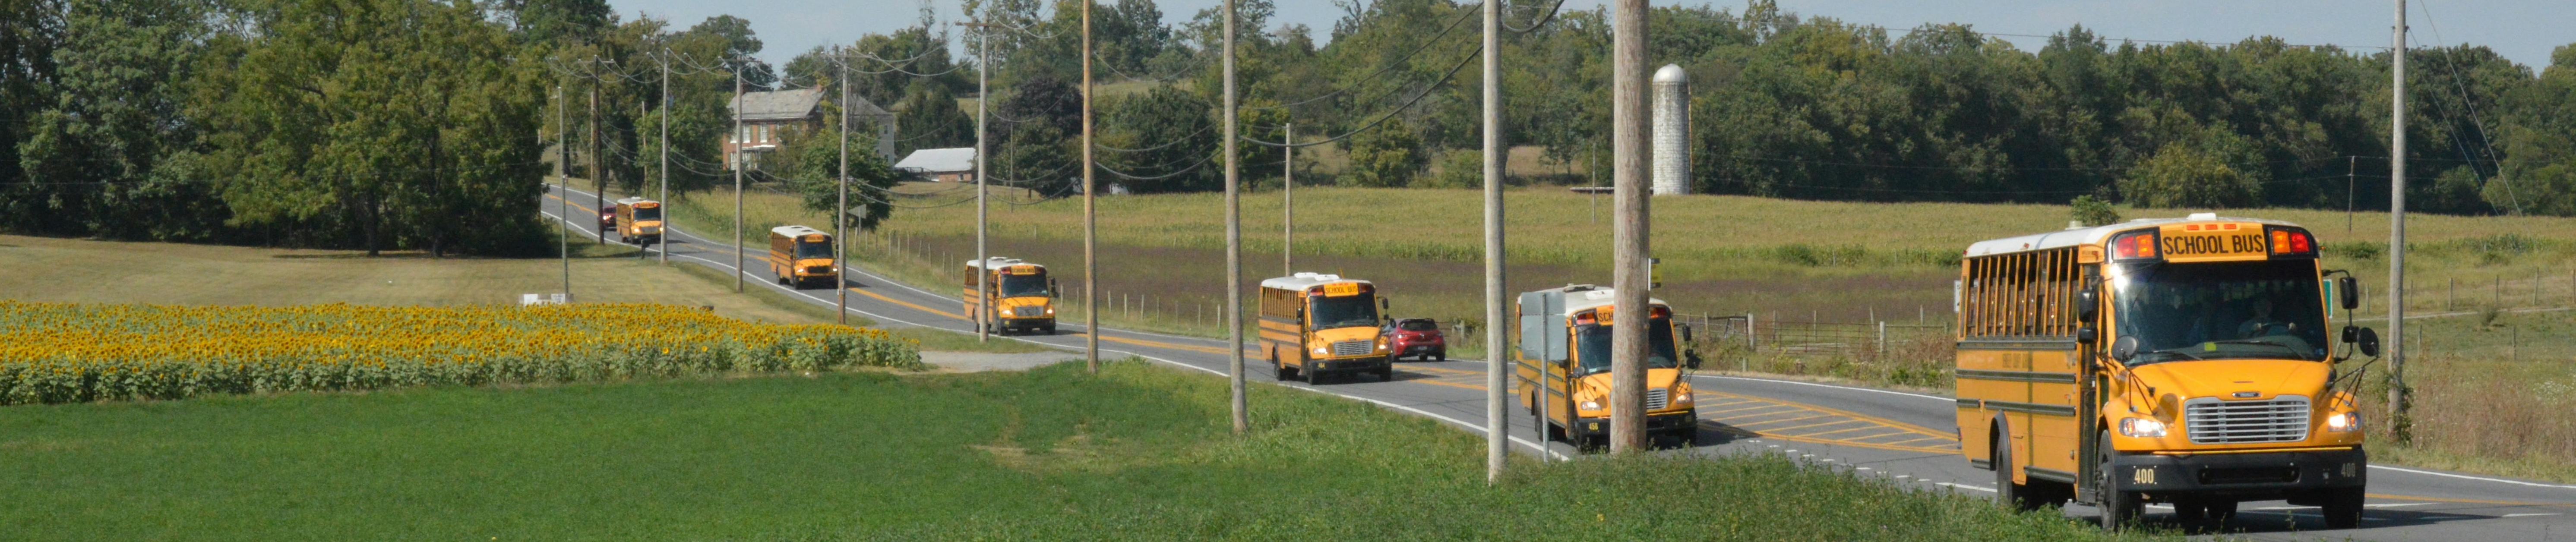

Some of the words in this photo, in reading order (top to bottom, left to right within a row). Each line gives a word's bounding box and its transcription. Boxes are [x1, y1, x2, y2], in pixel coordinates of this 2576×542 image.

[2163, 236, 2228, 255] SCHOOL
[2231, 234, 2263, 253] BUS
[1598, 312, 1614, 321] SCH
[2134, 469, 2154, 483] 400
[2341, 463, 2355, 477] 400
